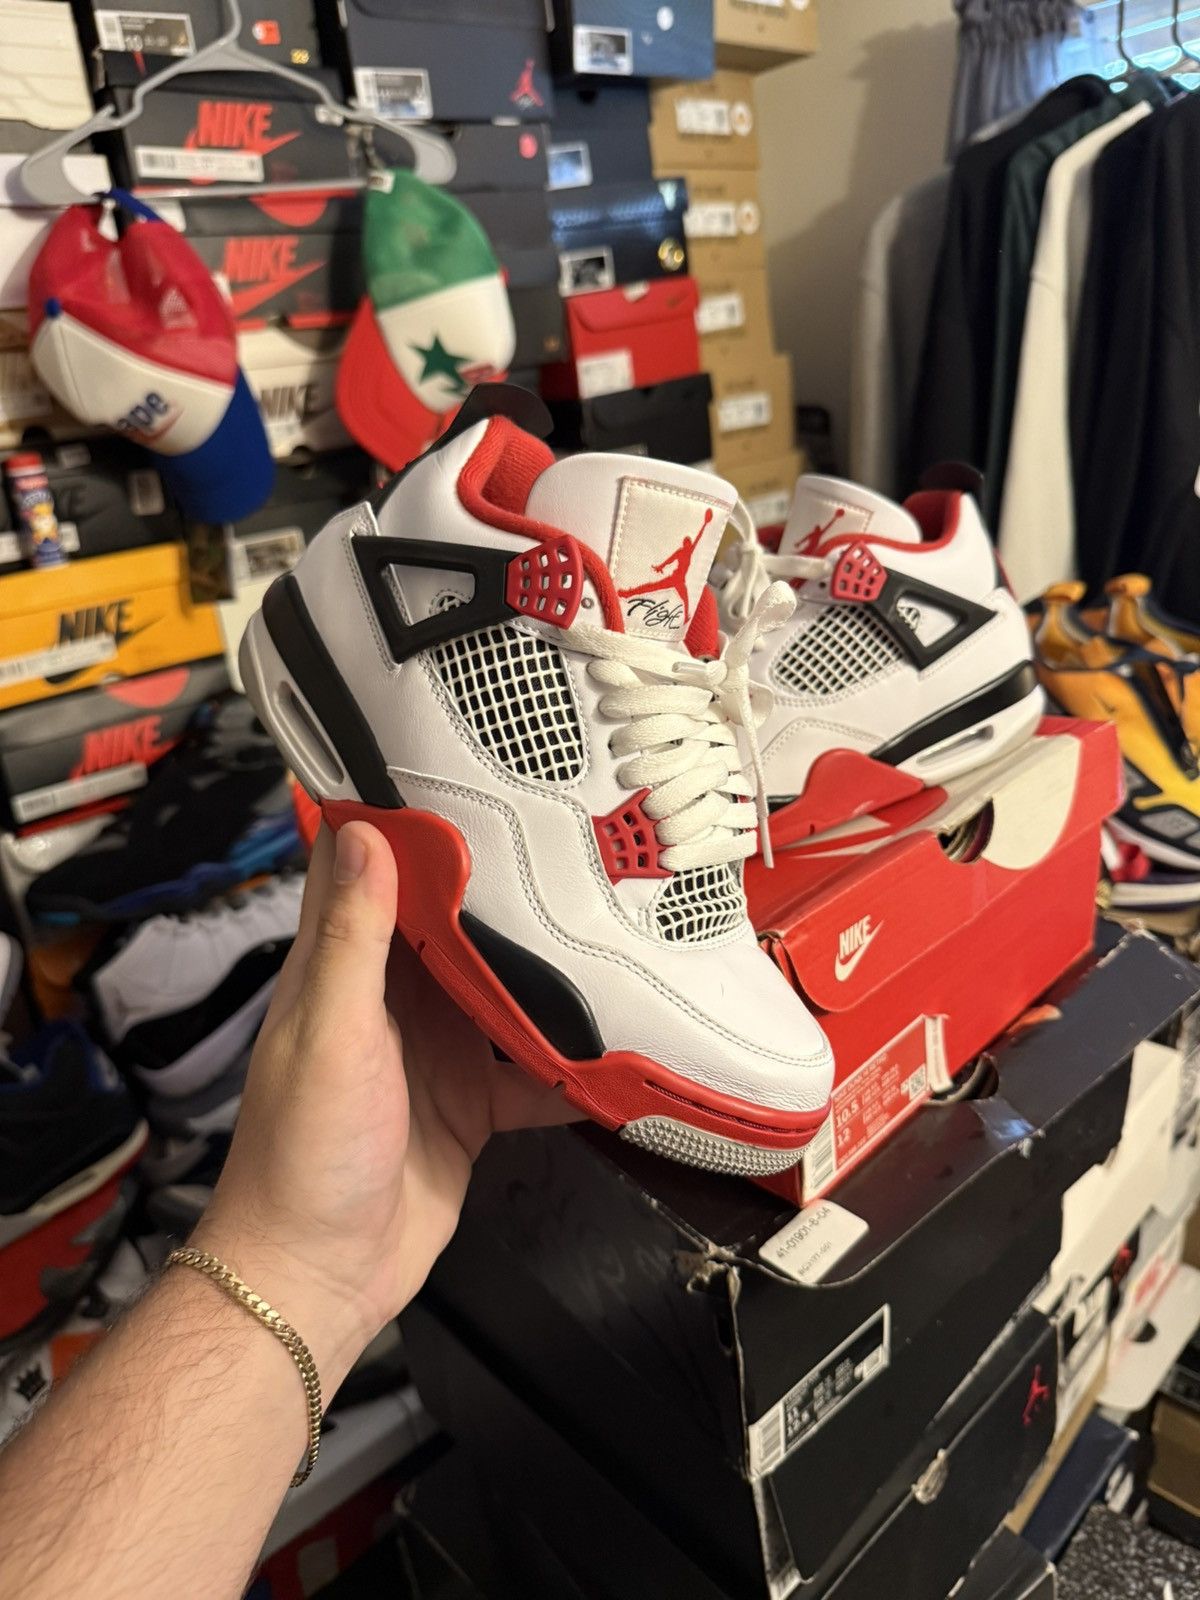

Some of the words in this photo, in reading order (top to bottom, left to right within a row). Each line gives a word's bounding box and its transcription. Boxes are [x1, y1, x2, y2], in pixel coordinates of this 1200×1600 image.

[197, 101, 273, 149] NIKE
[225, 235, 298, 281] NIKE
[58, 598, 134, 645] NIKE
[627, 598, 683, 630] Flight
[83, 714, 162, 772] NIKE
[839, 914, 871, 960] NIKE
[836, 1099, 860, 1129] 10.5
